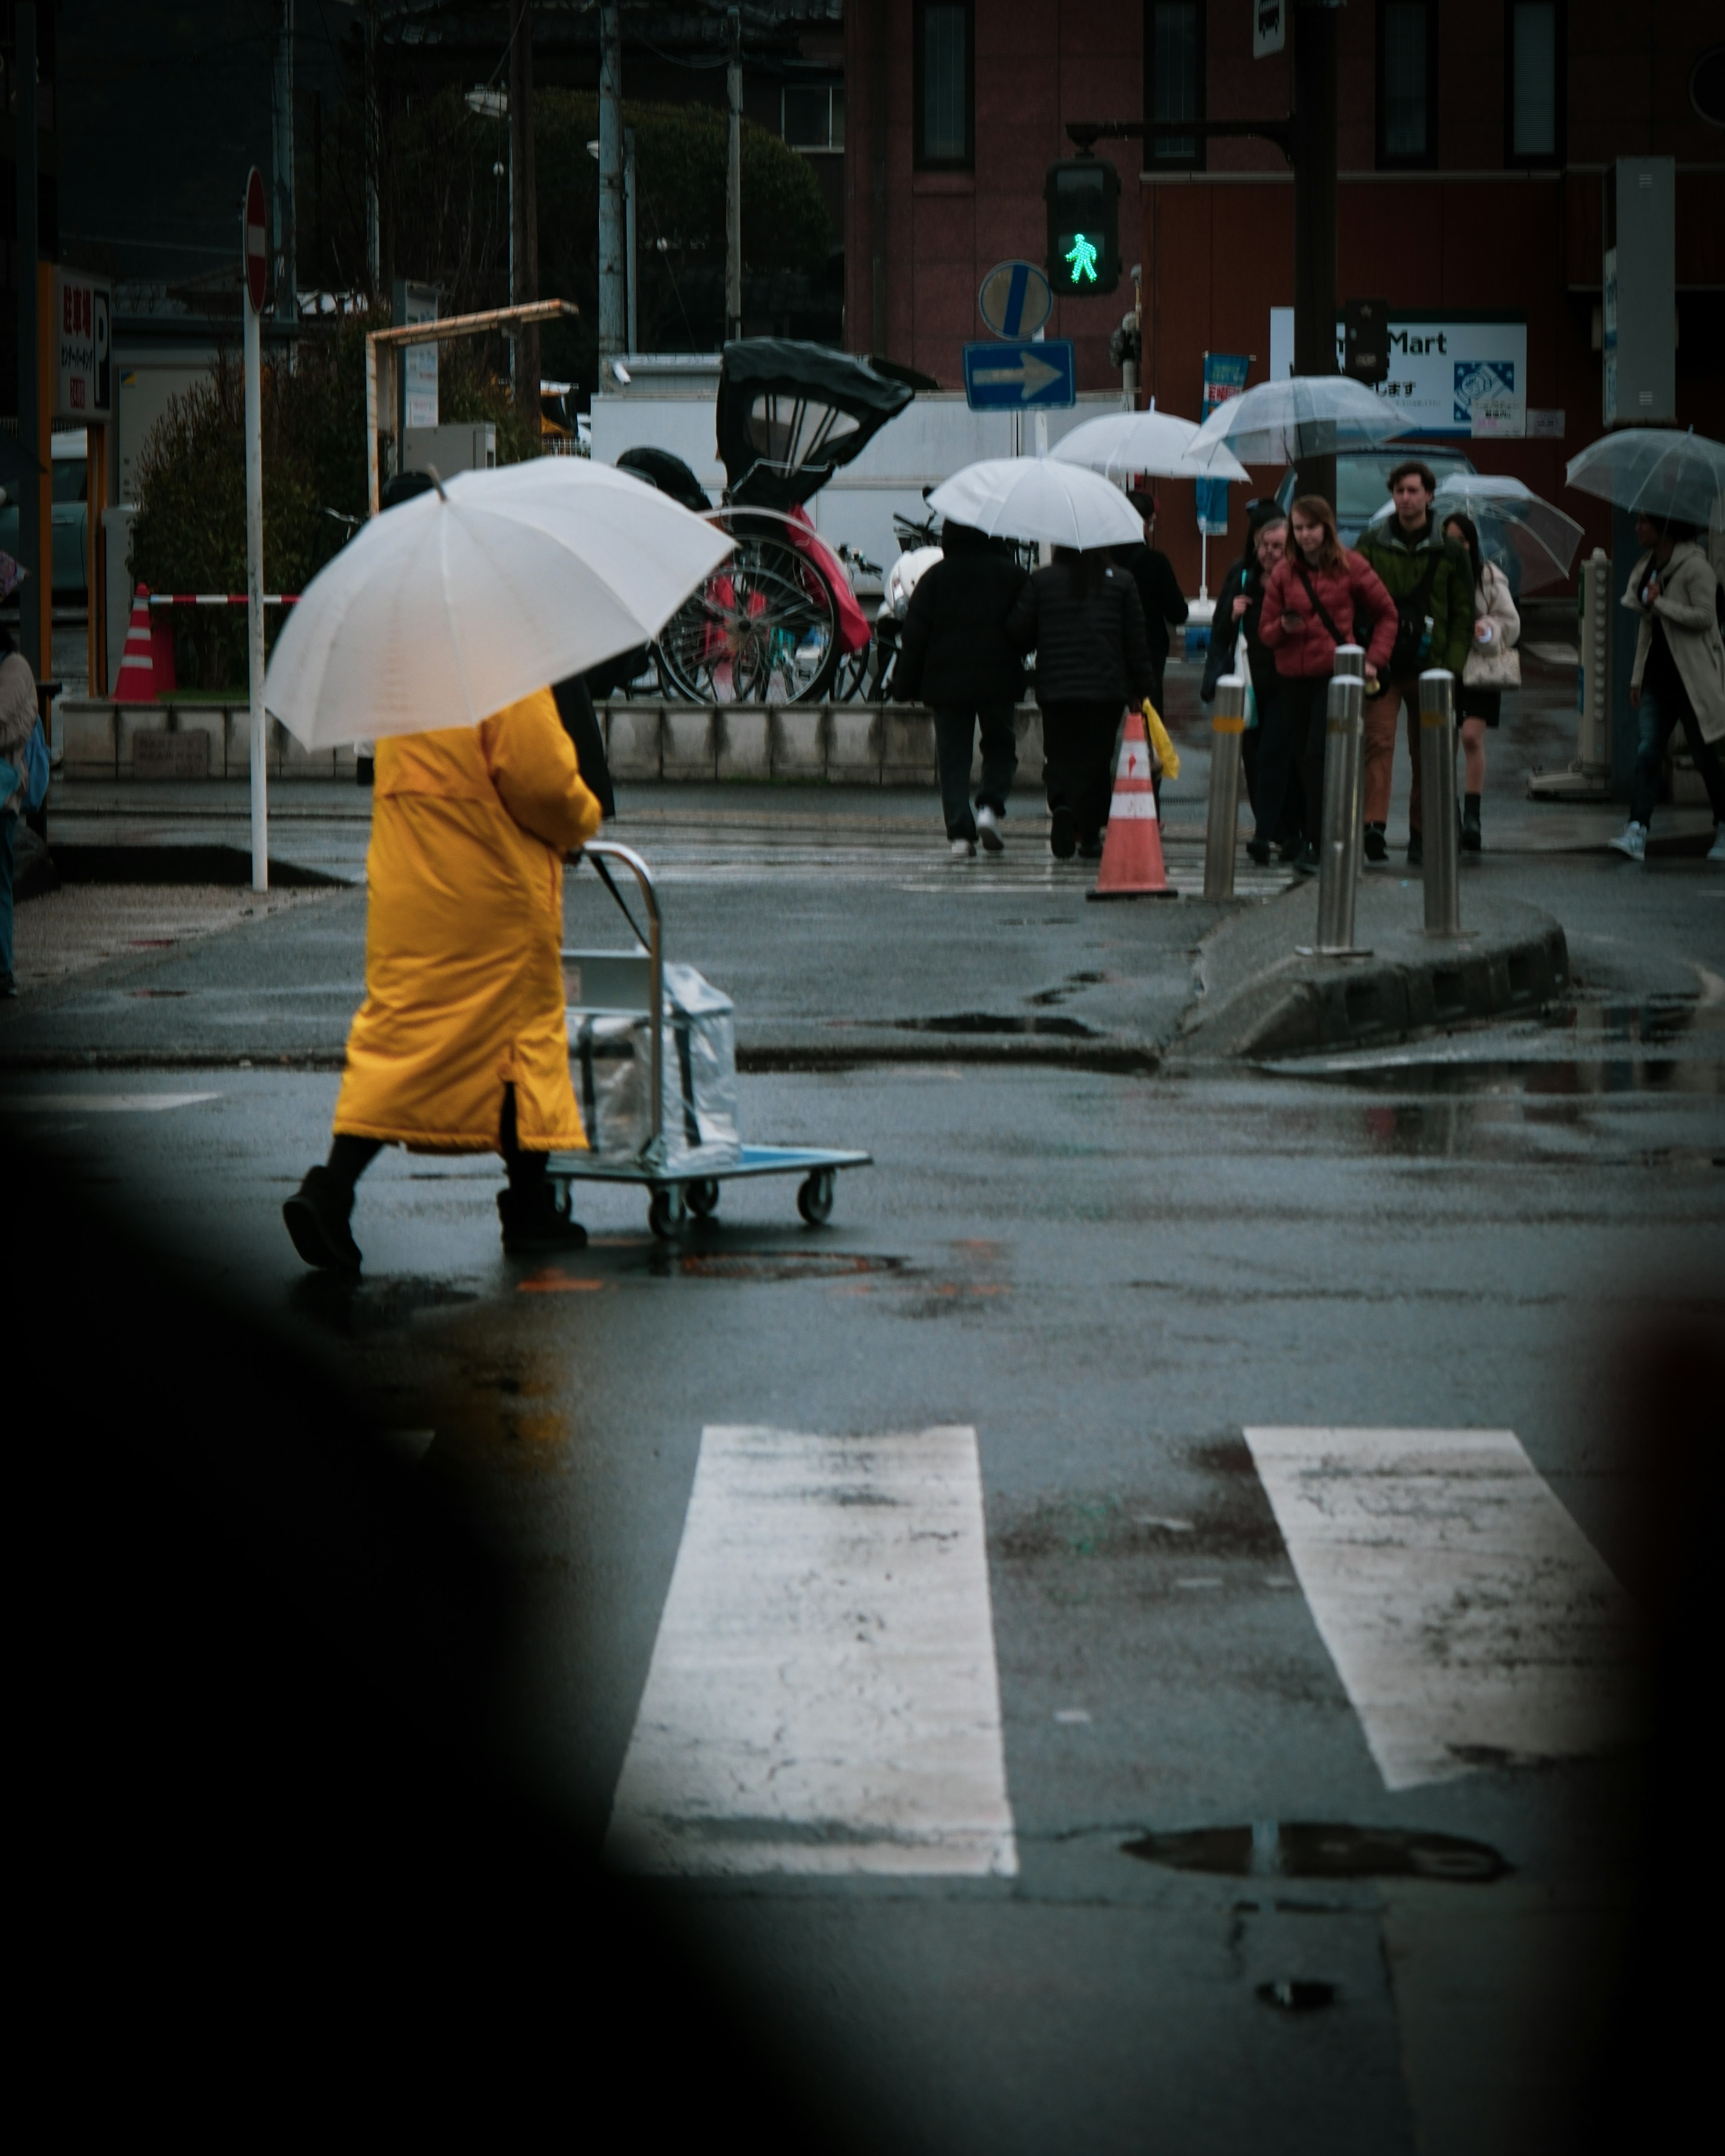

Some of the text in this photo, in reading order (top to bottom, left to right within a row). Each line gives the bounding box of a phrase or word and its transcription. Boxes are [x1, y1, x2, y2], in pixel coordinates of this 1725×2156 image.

[63, 284, 91, 339] 駐車場
[95, 296, 108, 402] P
[1387, 328, 1446, 355] Mart
